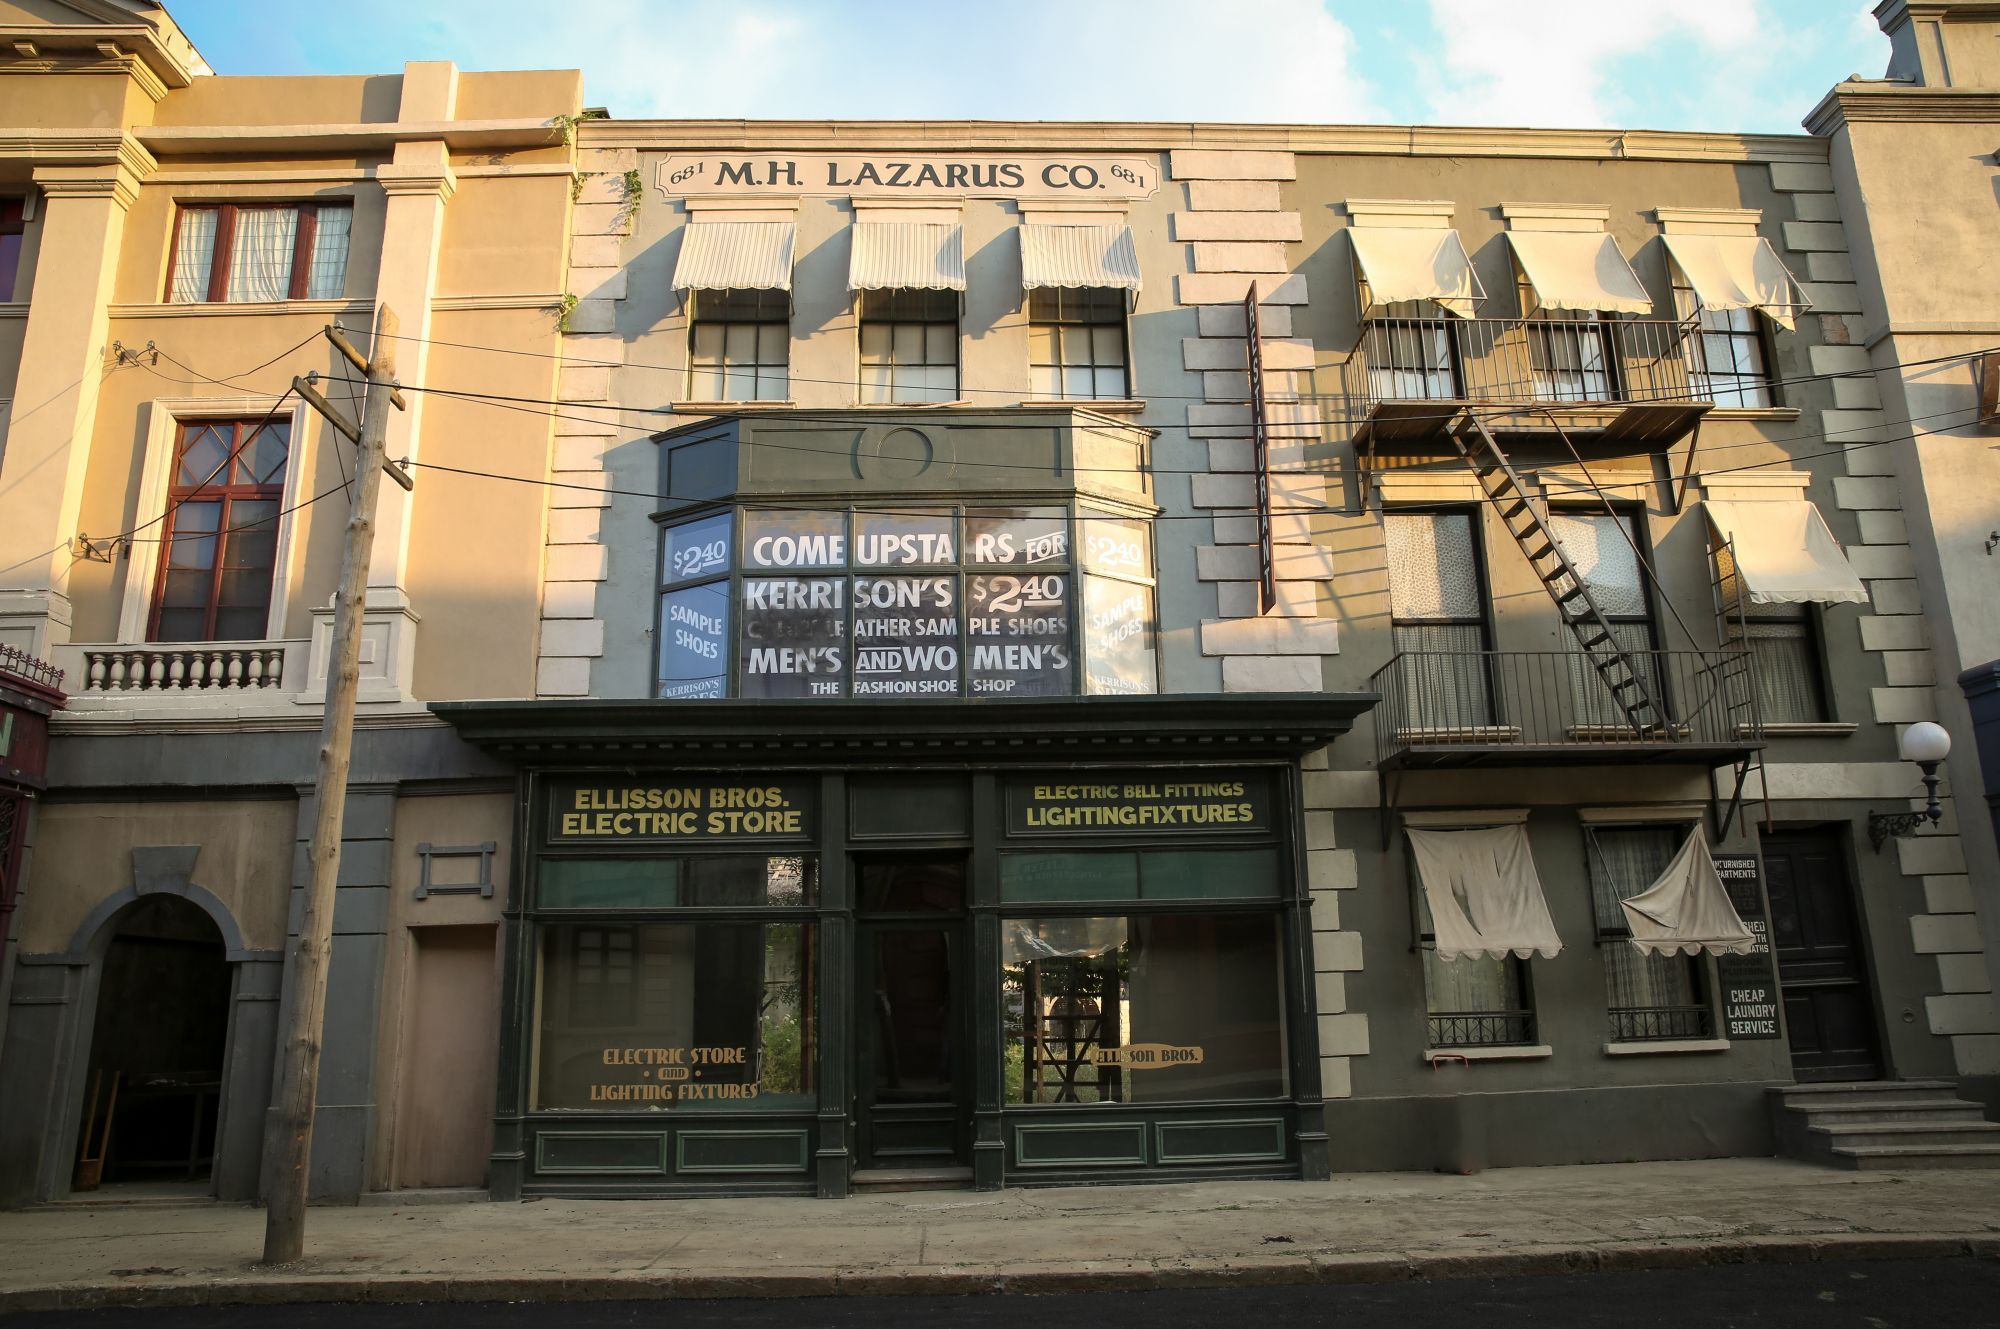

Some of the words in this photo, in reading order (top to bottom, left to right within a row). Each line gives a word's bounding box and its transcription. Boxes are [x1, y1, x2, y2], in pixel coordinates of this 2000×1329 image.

[670, 162, 704, 184] 681
[714, 161, 803, 186] M.H.
[827, 162, 1025, 188] LAZARUS
[1042, 164, 1105, 189] CO.
[1111, 165, 1146, 188] 681
[1248, 301, 1270, 595] RESTAURANT
[753, 535, 845, 566] COME
[1026, 534, 1066, 563] FOR
[670, 605, 722, 636] SAMPLE
[1093, 594, 1144, 630] SAMPLE
[1008, 617, 1067, 636] SHOES
[1100, 617, 1143, 651] SHOES
[675, 629, 718, 659] SHOES
[748, 646, 842, 674] MEN'S
[856, 650, 902, 670] AND
[666, 679, 720, 698] KERRISON'S
[811, 682, 839, 695] THE
[854, 681, 917, 694] FASHION
[919, 680, 958, 692] SHOE
[973, 679, 1016, 692] SHOP
[575, 788, 700, 810] ELLISSON
[709, 787, 789, 808] BROS.
[1034, 784, 1119, 800] ELECTRIC
[1124, 784, 1161, 799] BELL
[1164, 782, 1245, 798] FITTINGS
[562, 812, 698, 835] ELECTRIC
[707, 811, 801, 833] STORE
[1027, 805, 1136, 826] LIGHTING
[1139, 803, 1254, 824] FIXTURES
[1716, 869, 1757, 879] PARTMENTS
[1731, 989, 1766, 1003] CHEAP
[1727, 1004, 1776, 1018] LAUNDRY
[1731, 1020, 1776, 1034] SERVICE
[603, 1048, 685, 1065] ELECTRIC
[690, 1047, 746, 1064] STORE
[1161, 1048, 1198, 1062] BROS.
[590, 1084, 673, 1100] LIGHTING
[678, 1083, 758, 1099] FIXTURES
